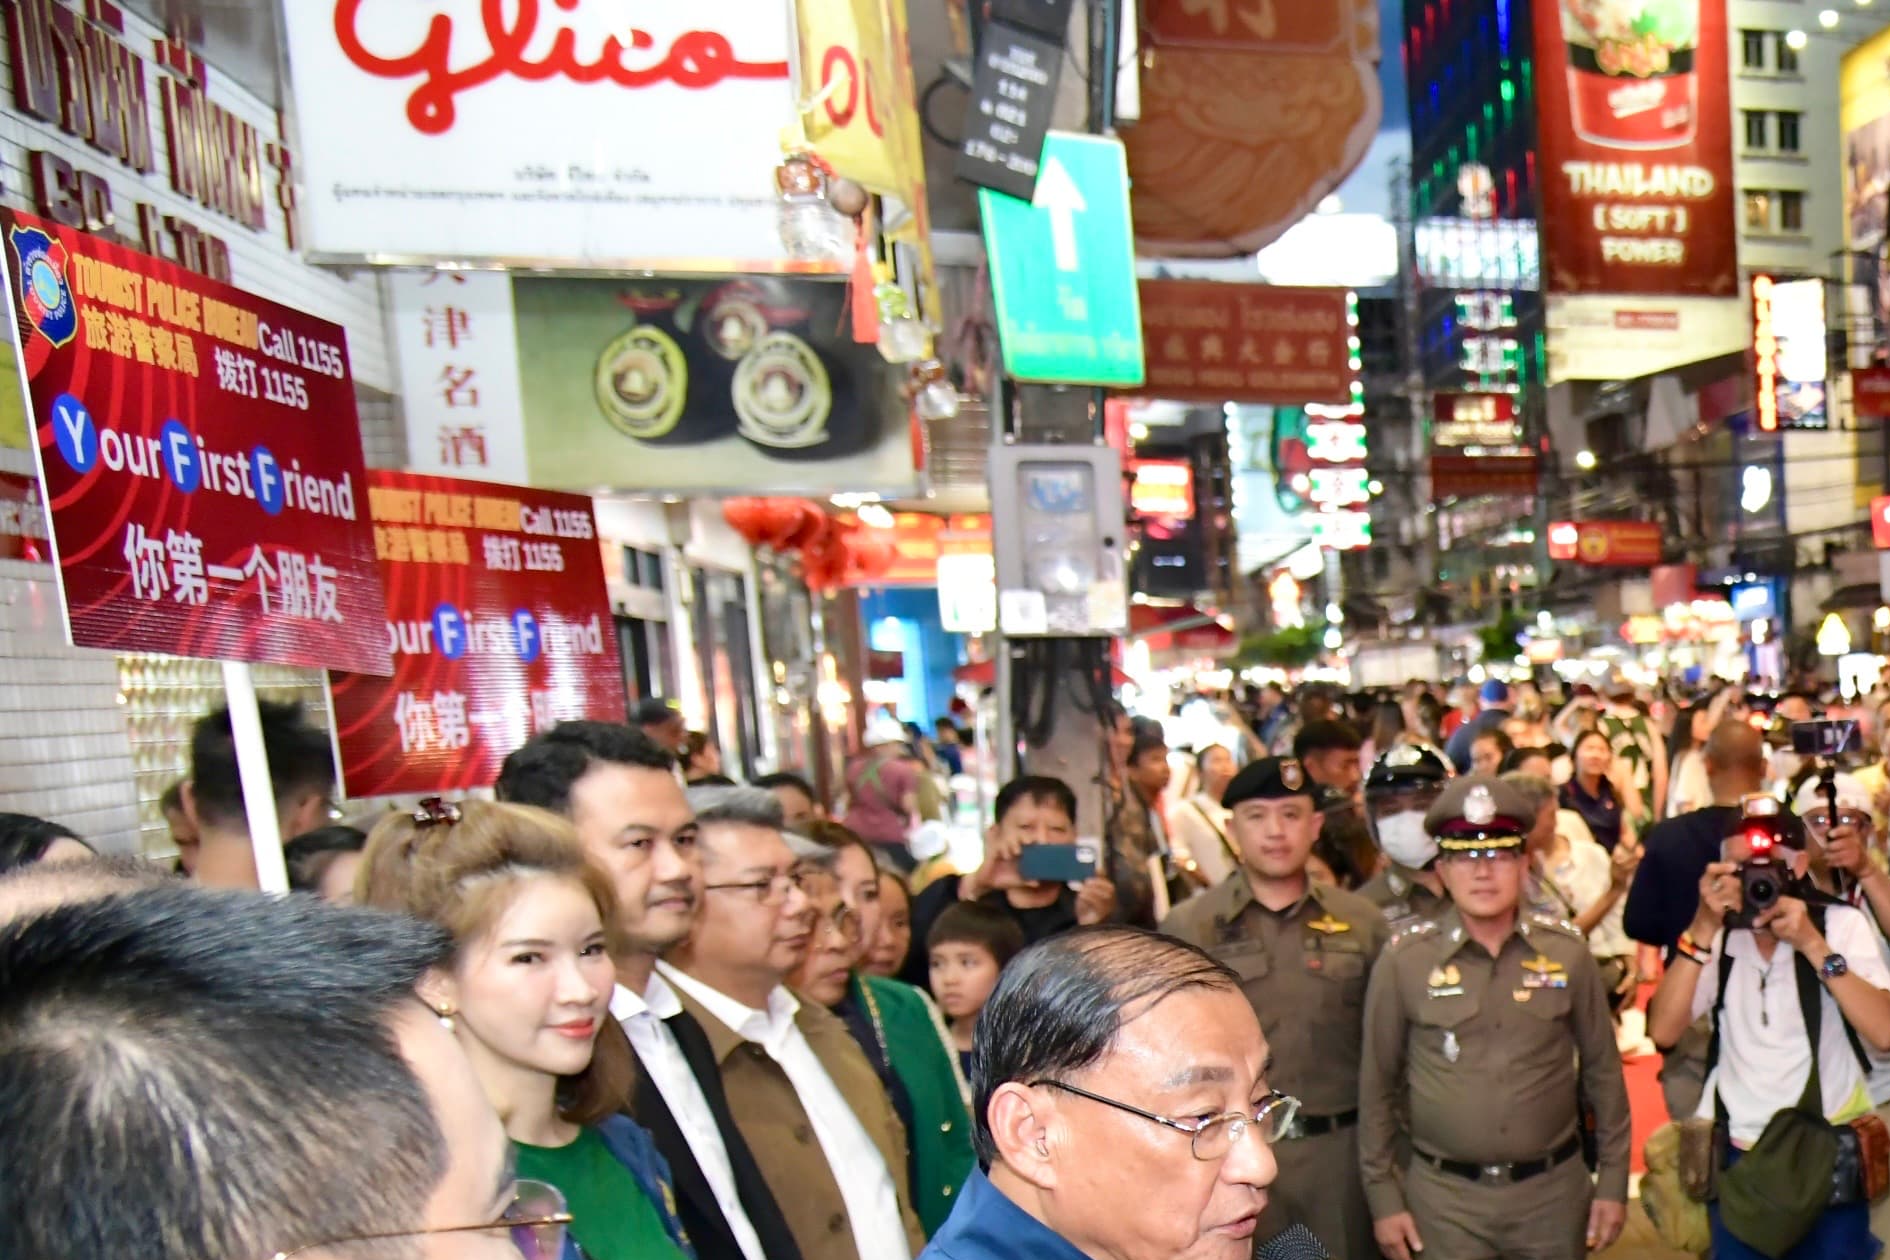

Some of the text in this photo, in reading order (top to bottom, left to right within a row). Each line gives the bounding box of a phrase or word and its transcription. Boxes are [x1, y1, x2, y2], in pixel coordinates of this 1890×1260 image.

[1562, 160, 1716, 197] THAILAND
[1600, 237, 1684, 265] POWER
[73, 253, 144, 314] TOURIST
[147, 278, 201, 331] POLICE
[258, 322, 298, 364] Call
[299, 336, 345, 380] 1155
[261, 367, 310, 411] 1155
[520, 506, 553, 536] Call
[554, 509, 593, 539] 1155
[123, 524, 346, 625] 你第一个朋友
[523, 541, 565, 572] 1155
[387, 620, 433, 655] our
